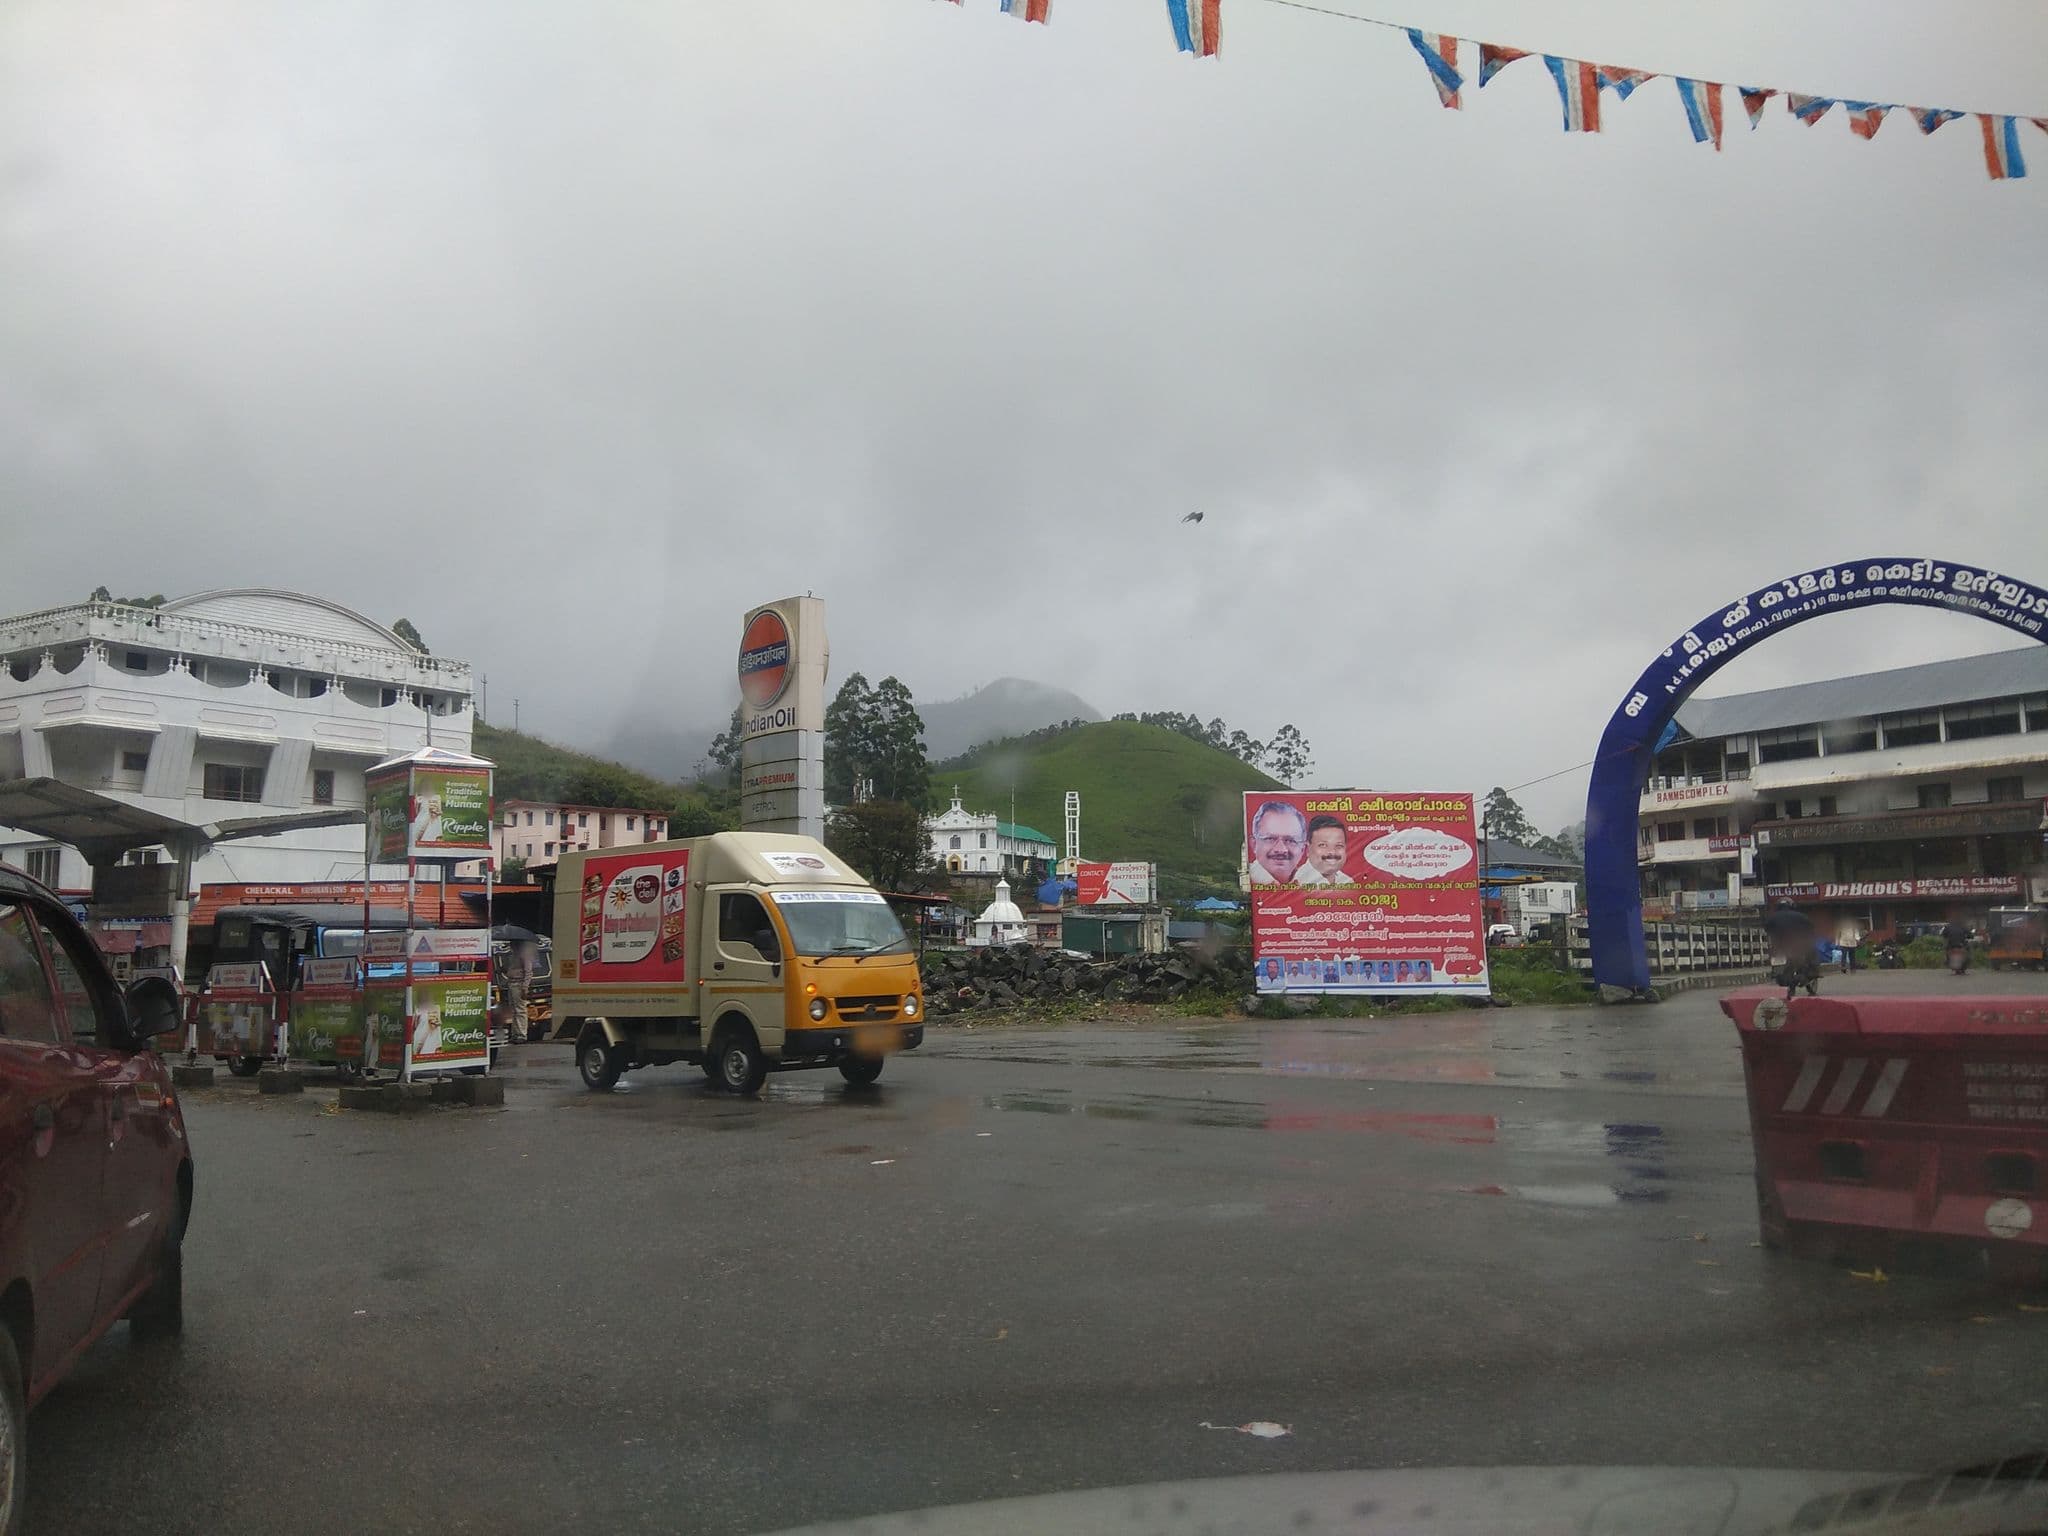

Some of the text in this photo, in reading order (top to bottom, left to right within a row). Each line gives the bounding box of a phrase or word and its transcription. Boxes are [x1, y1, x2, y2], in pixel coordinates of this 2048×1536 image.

[445, 799, 483, 809] Munnar
[442, 817, 486, 834] Ripple
[1917, 878, 1968, 888] DENTAL
[1971, 876, 2017, 886] CLINIC
[445, 1008, 482, 1017] Munnar
[442, 1027, 486, 1043] Ripple
